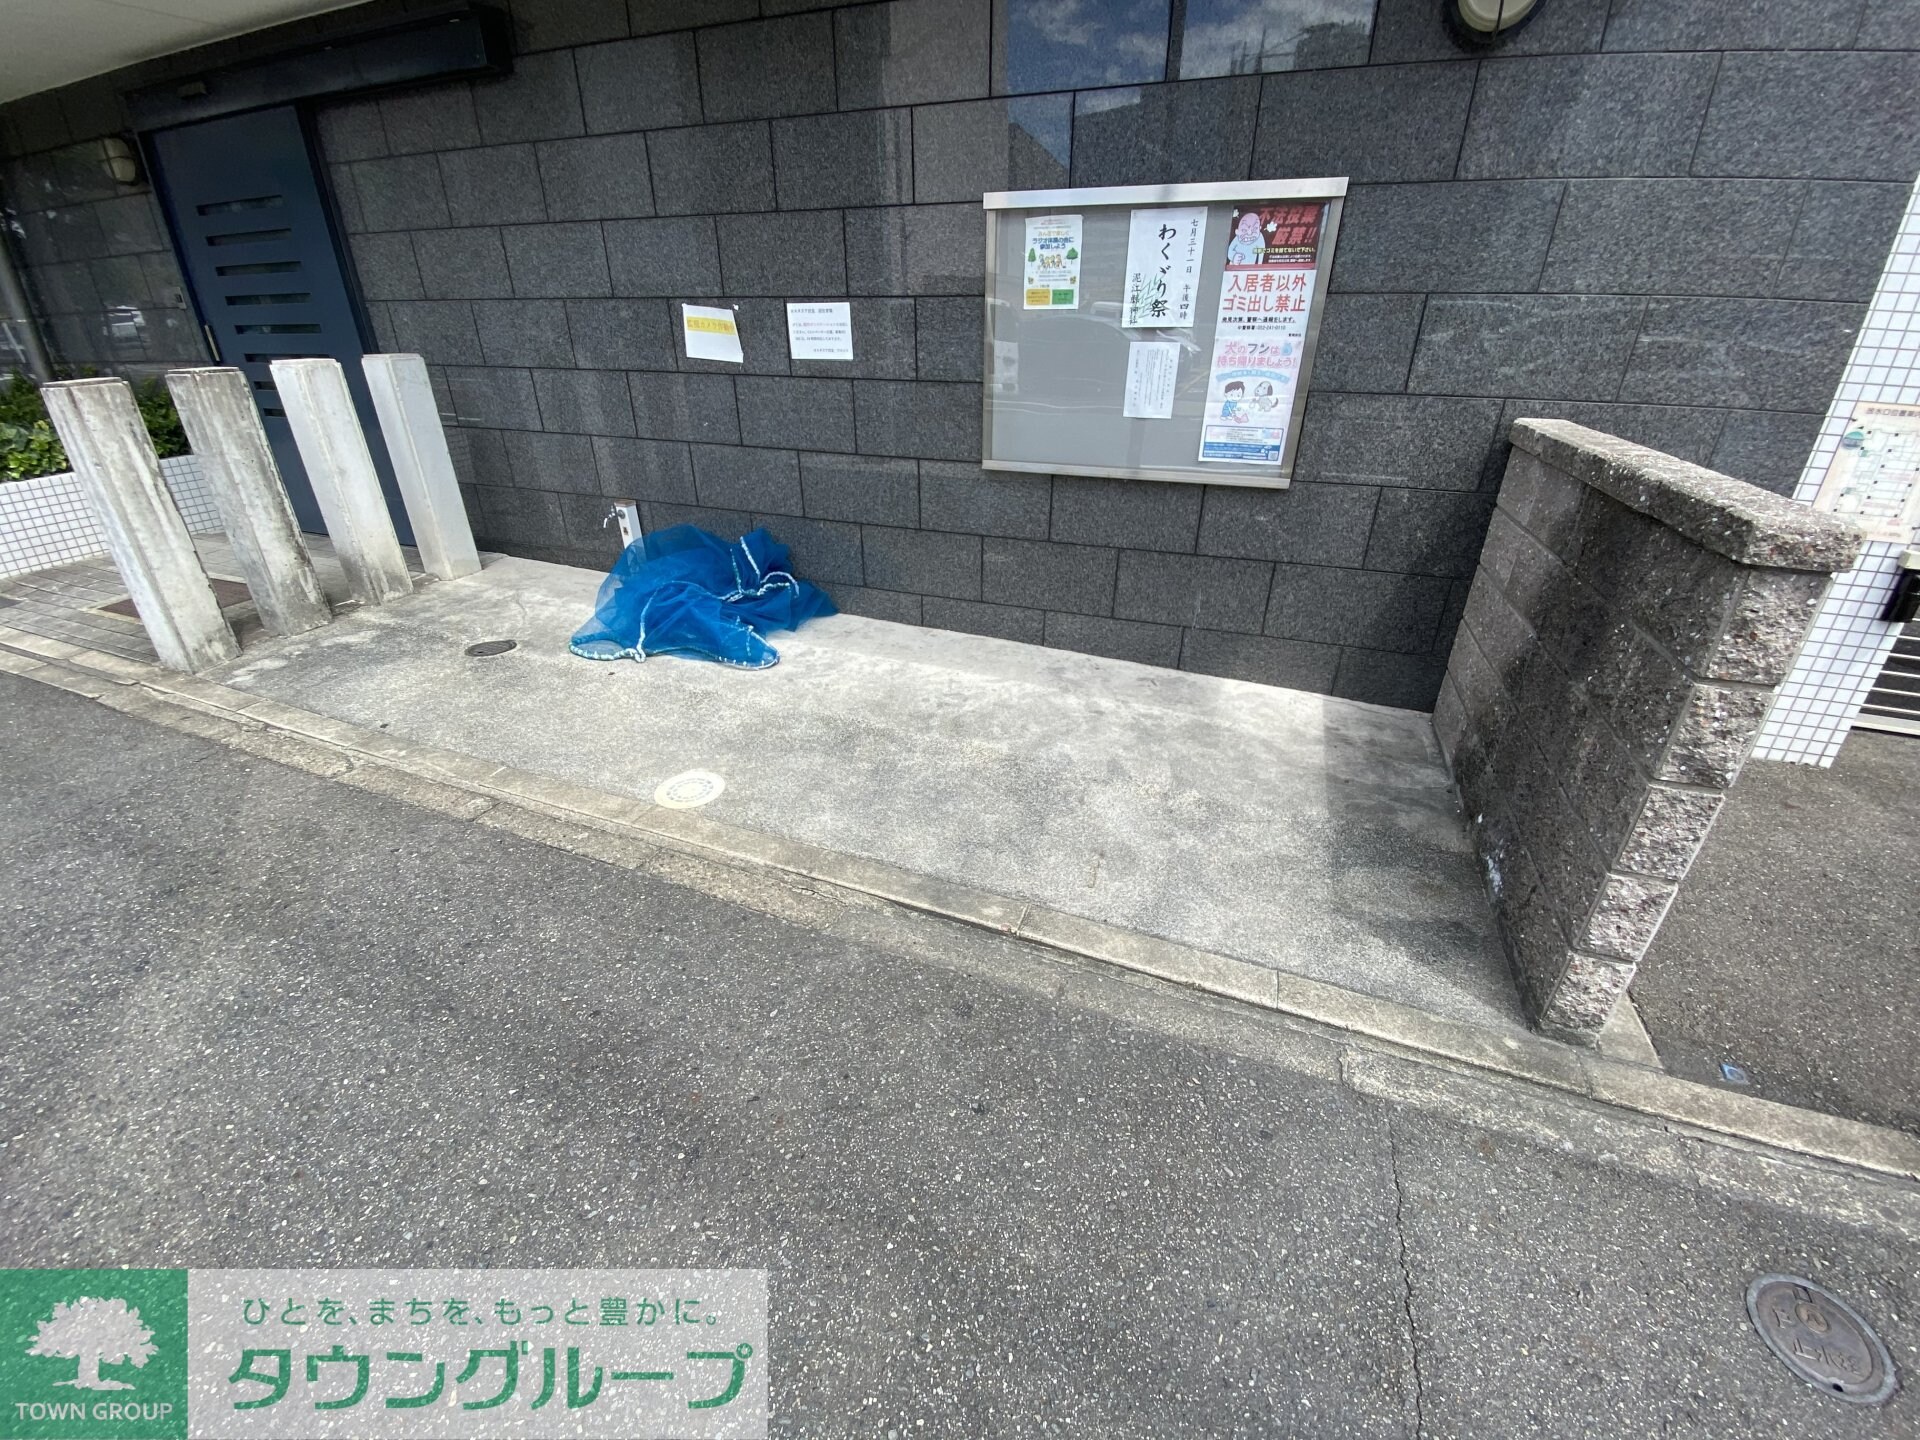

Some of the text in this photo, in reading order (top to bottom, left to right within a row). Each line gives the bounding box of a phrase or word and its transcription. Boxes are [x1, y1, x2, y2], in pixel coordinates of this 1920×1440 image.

[1259, 205, 1320, 225] 不法投棄
[1179, 219, 1199, 320] 七月三十一日 午後四時
[1227, 273, 1307, 293] 入居者以外
[1222, 293, 1306, 313] ゴミ出し禁止
[1225, 341, 1281, 356] 犬のフンは
[1216, 355, 1298, 369] 持ち帰りましょう!
